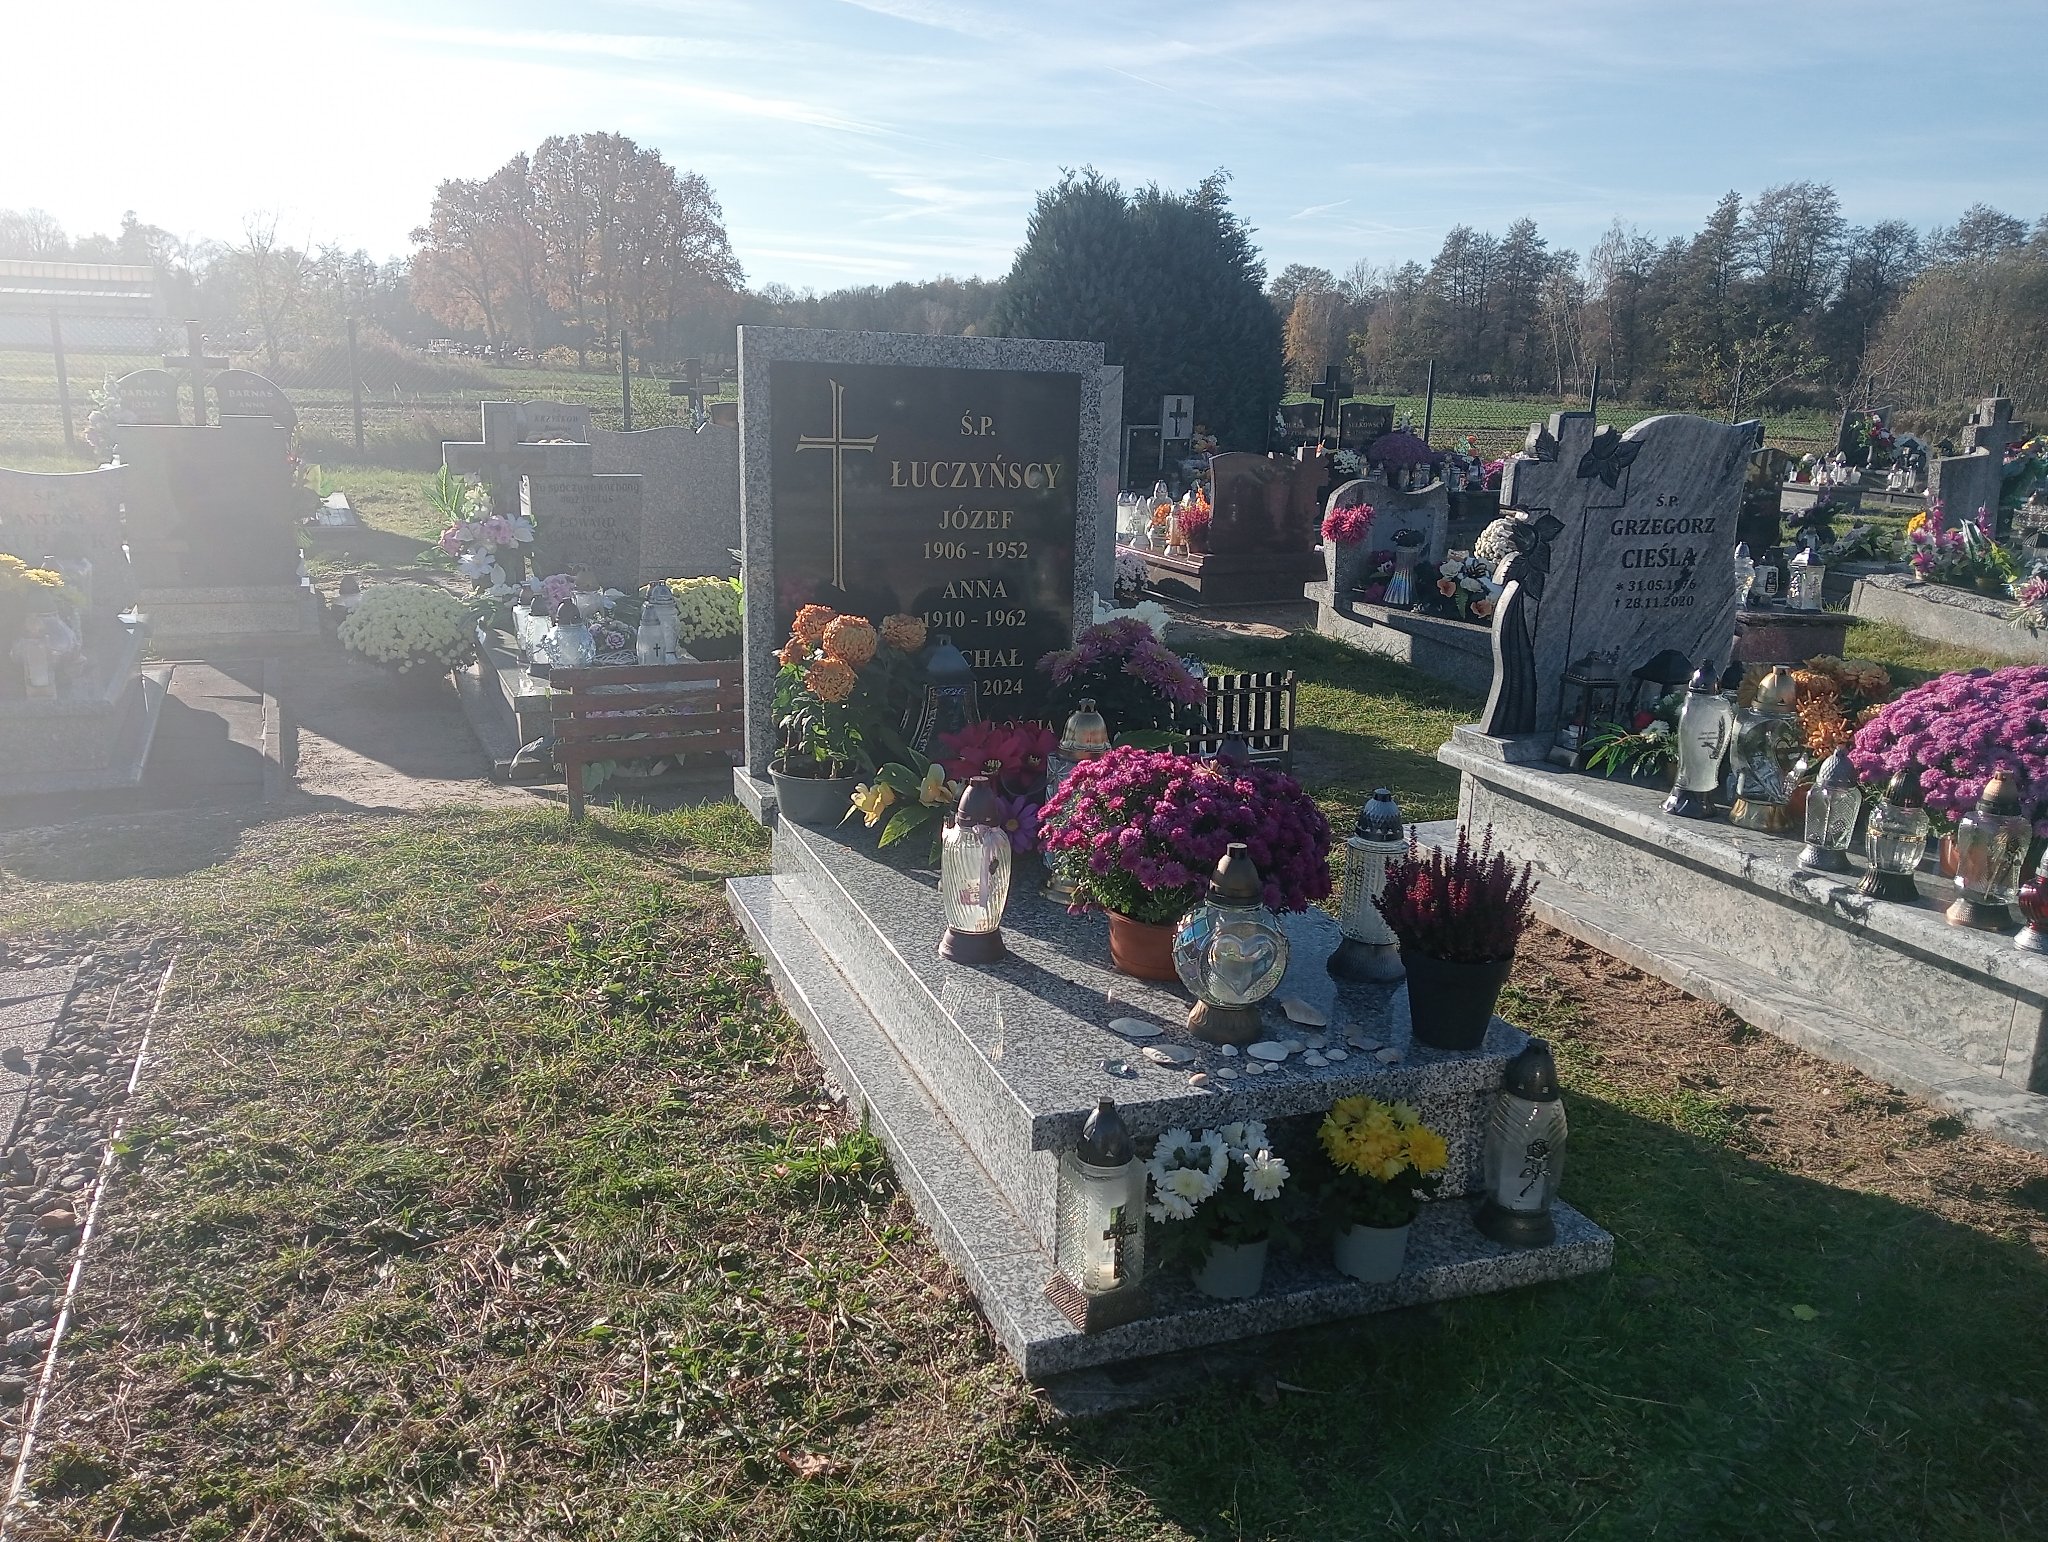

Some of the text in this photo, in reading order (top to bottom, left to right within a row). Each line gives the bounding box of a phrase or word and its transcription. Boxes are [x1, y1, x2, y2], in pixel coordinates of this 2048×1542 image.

[960, 410, 996, 436] Ś.P.
[890, 454, 1061, 489] ŁUCZYŃSCY
[1656, 493, 1679, 507] Ś.P.
[938, 504, 1014, 530] JÓZEF
[1610, 518, 1716, 535] GRZEGORZ
[923, 541, 967, 559] 1906
[986, 541, 1029, 559] 1952
[942, 580, 1008, 598] ANNA
[1625, 595, 1695, 609] 28.11.2020
[923, 610, 966, 628] 1910
[985, 609, 1027, 627] 1962
[960, 649, 1024, 668] CHAŁ
[982, 679, 1024, 696] 2024
